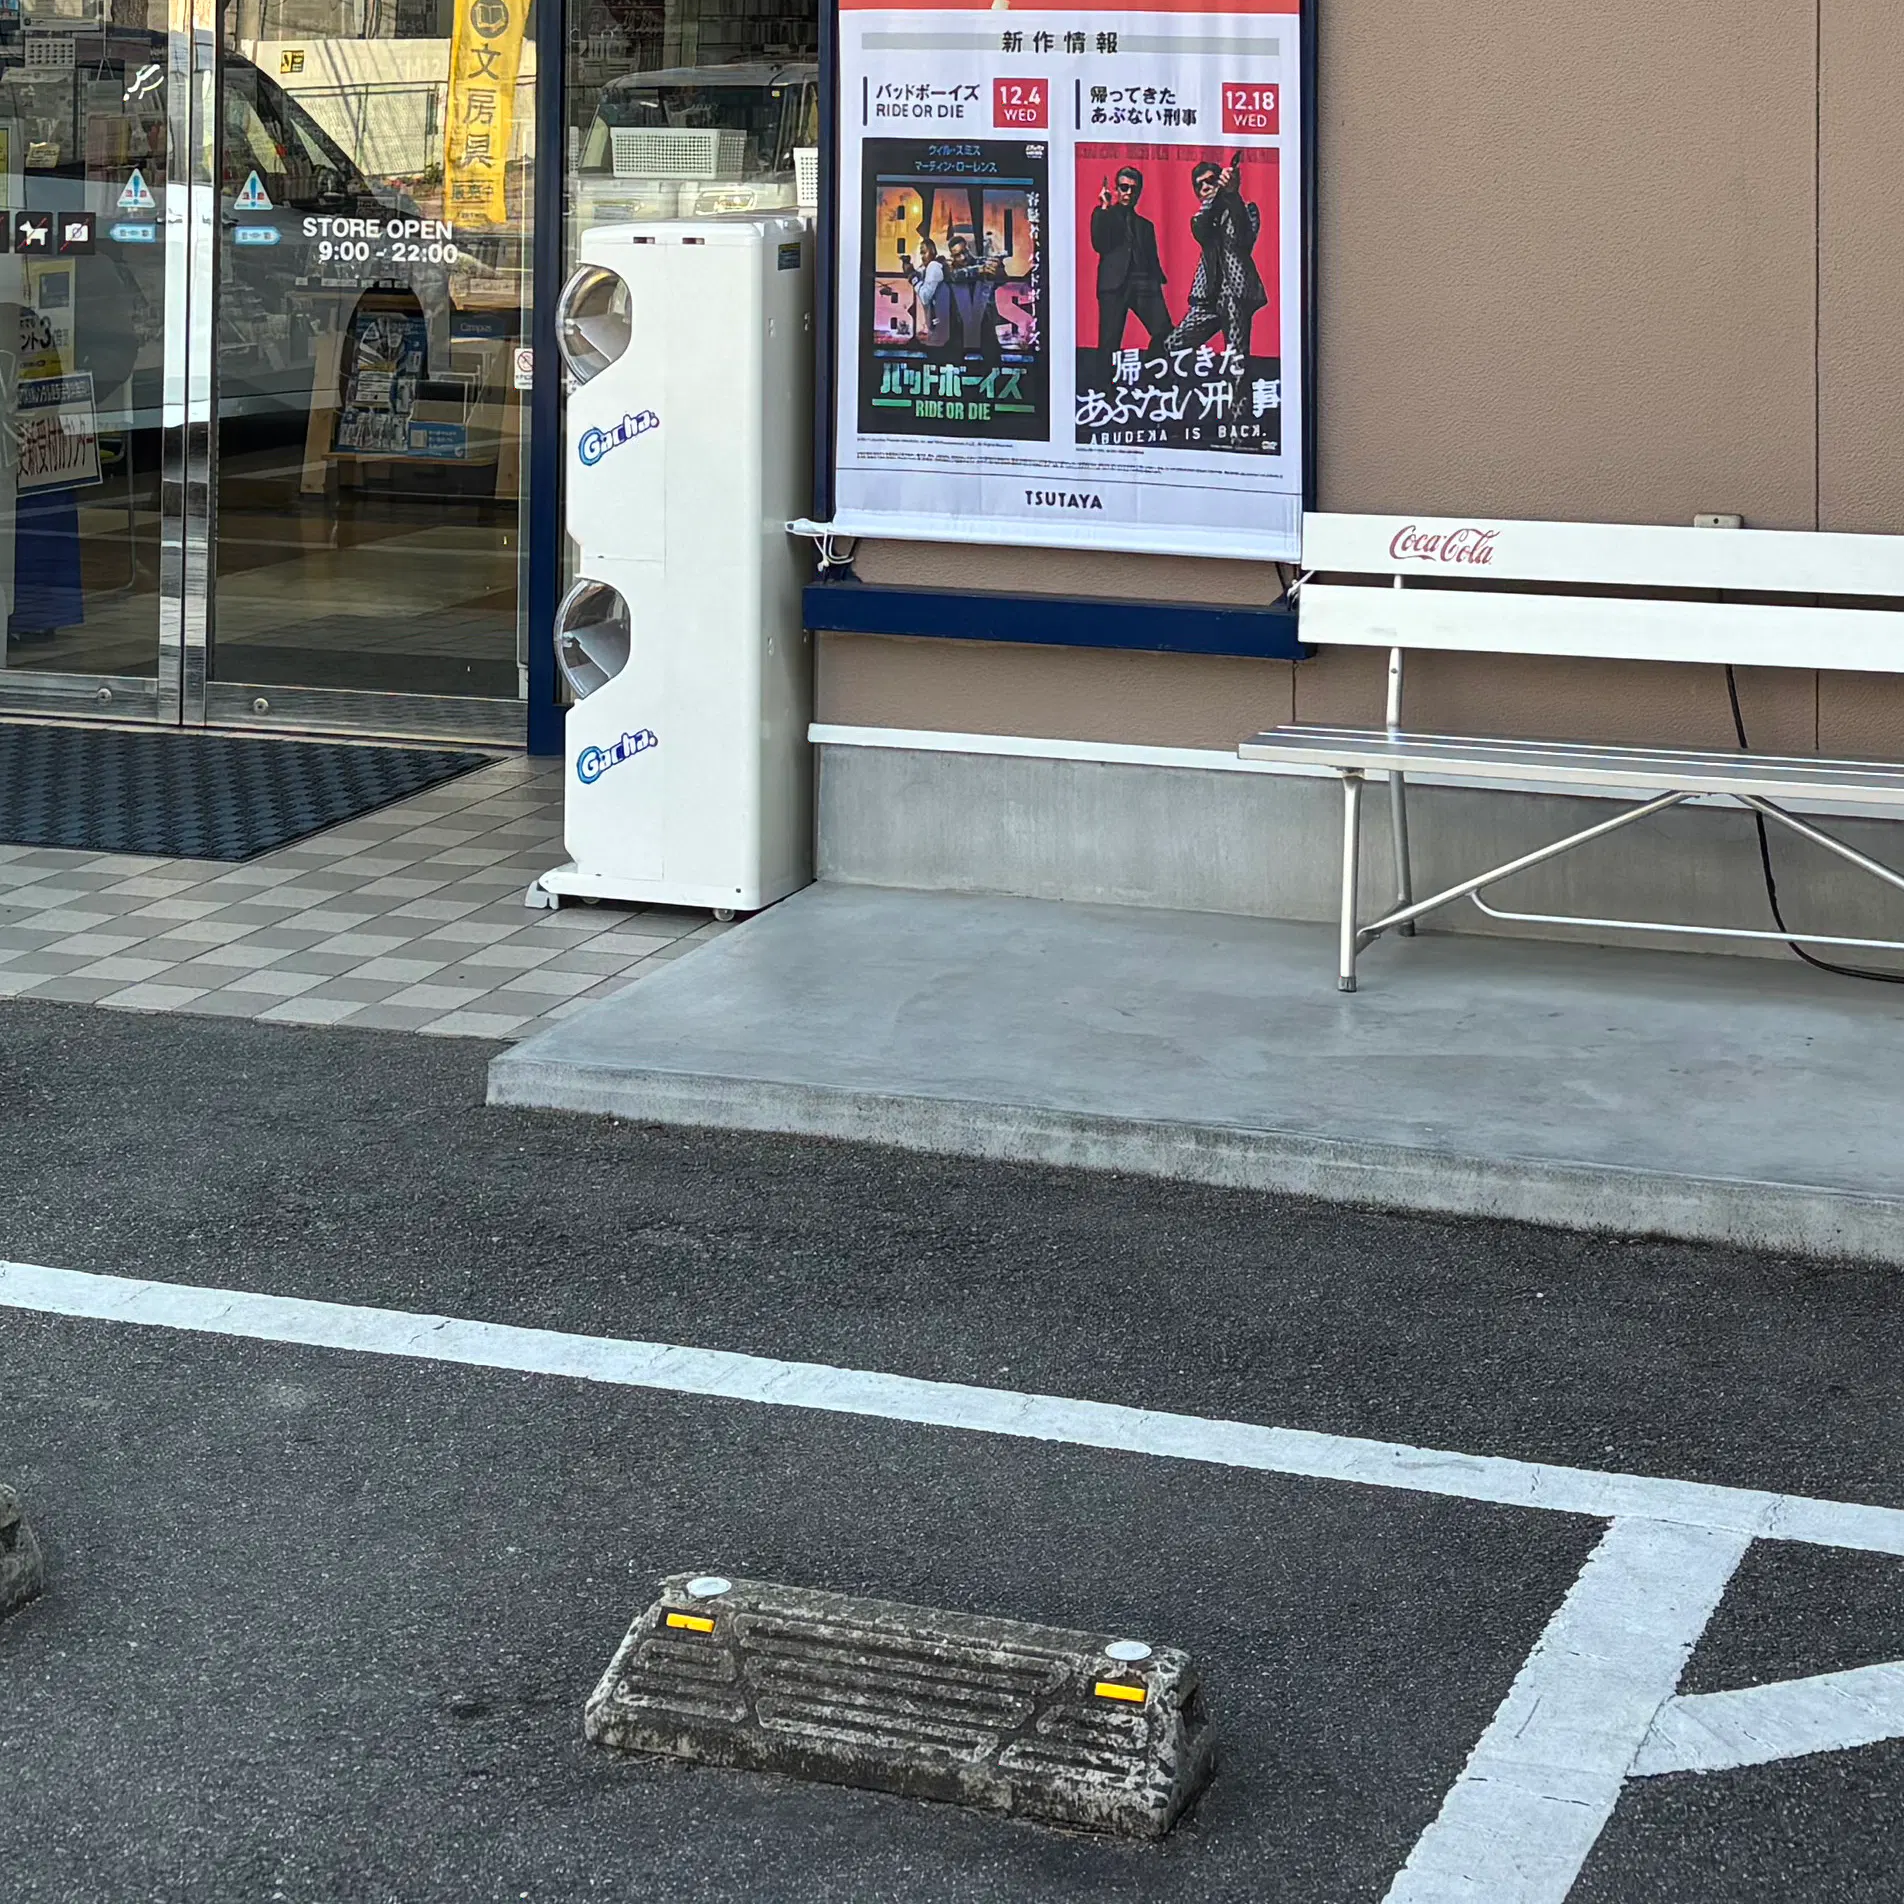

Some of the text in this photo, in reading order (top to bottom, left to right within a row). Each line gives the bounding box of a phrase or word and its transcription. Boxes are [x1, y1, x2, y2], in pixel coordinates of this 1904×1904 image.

[1001, 31, 1119, 54] 新作情報
[875, 82, 981, 103] バッドボーイズ
[998, 86, 1042, 106] 12.4
[1089, 85, 1177, 105] 帰ってきた
[1225, 90, 1275, 112] 12.18
[460, 42, 502, 169] 文房具
[876, 103, 965, 119] RIDE OR DIE
[1003, 108, 1037, 123] WED
[1090, 106, 1198, 127] あぶない刑事
[1232, 113, 1268, 128] WED
[302, 216, 454, 240] STORE OPEN
[874, 186, 1035, 278] BAD
[318, 241, 370, 262] 9:00
[389, 244, 459, 265] 22:00
[1111, 343, 1246, 386] 帰ってきた
[880, 362, 1028, 400] バッドボーイズ
[915, 399, 992, 421] RIDE OR DIE
[1184, 427, 1202, 441] IS
[1024, 488, 1104, 511] TSUTAYA
[1388, 524, 1500, 567] Coca-Cola
